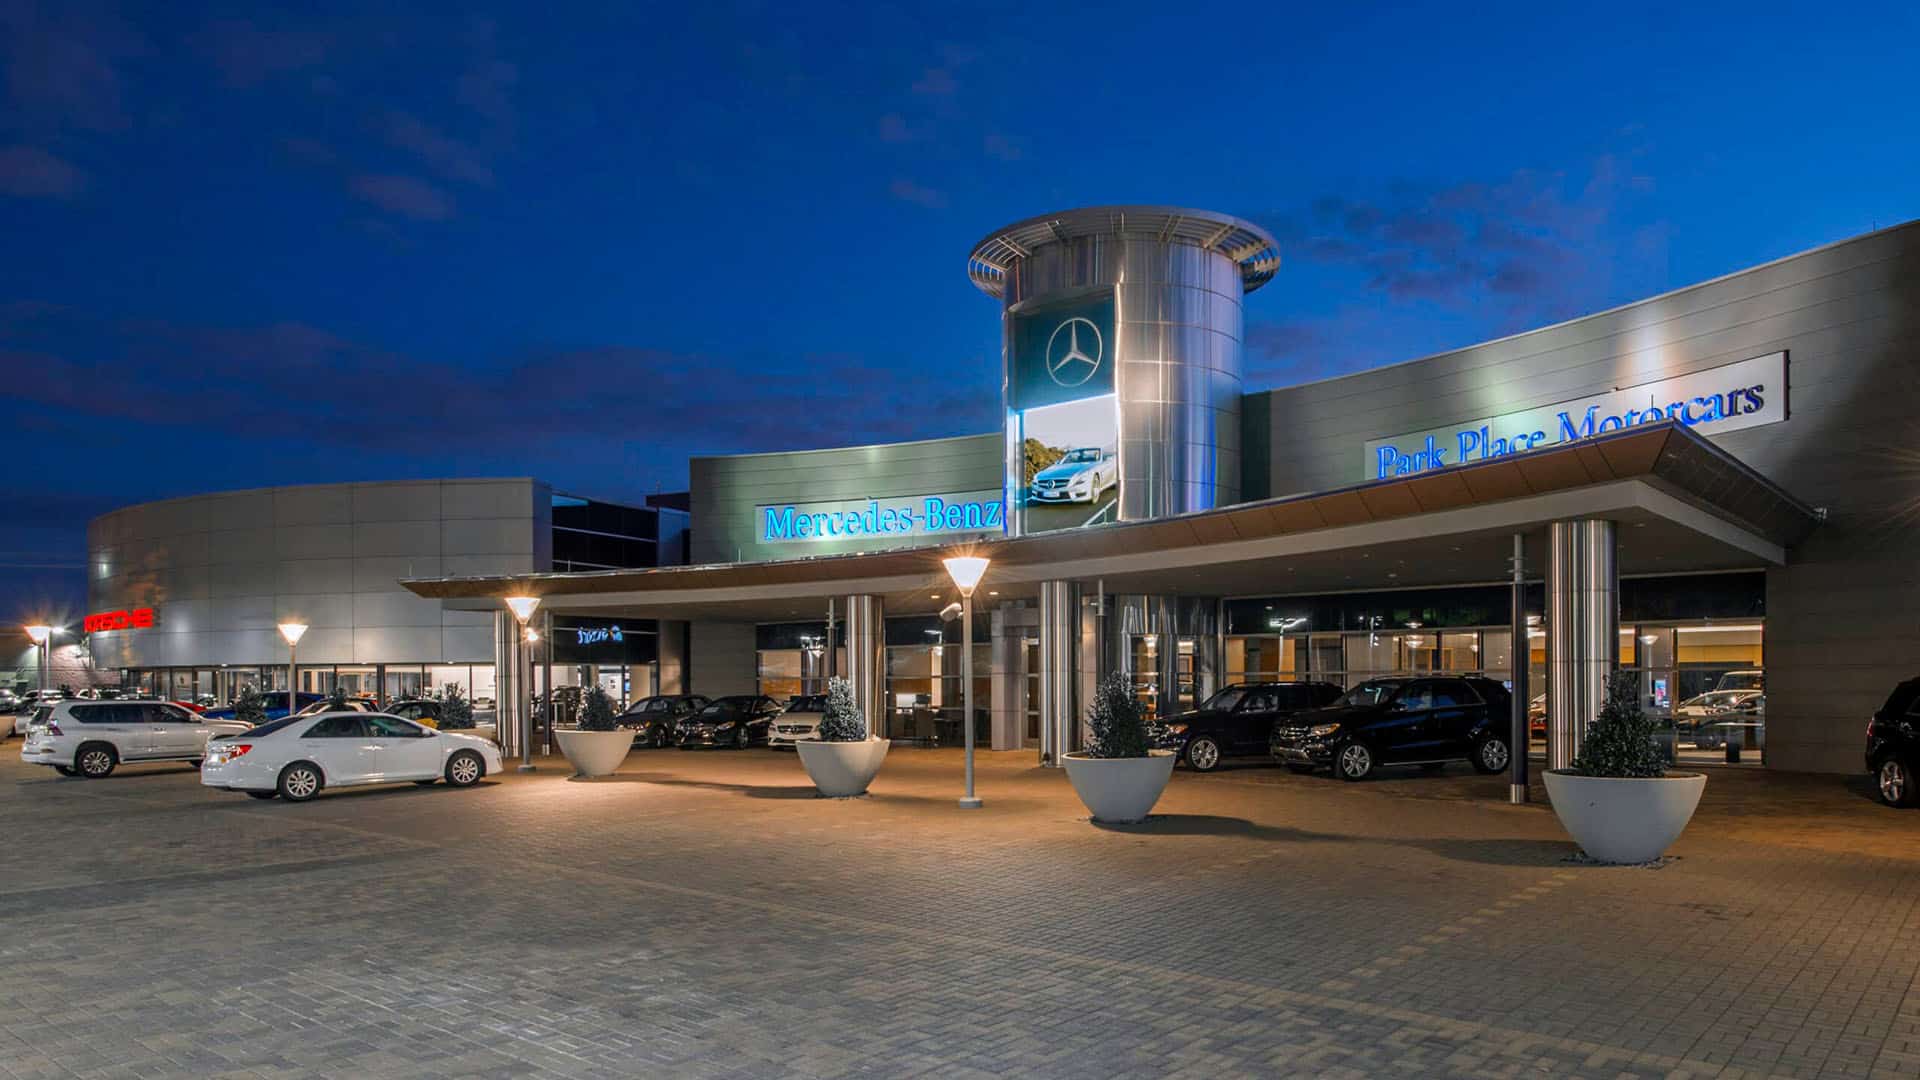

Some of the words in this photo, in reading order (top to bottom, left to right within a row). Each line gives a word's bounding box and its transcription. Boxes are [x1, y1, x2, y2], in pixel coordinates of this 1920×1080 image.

[1376, 435, 1448, 481] Park
[1456, 425, 1546, 464] Place
[1556, 383, 1765, 442] Motorcars
[764, 497, 1002, 541] Mercedes-Benz
